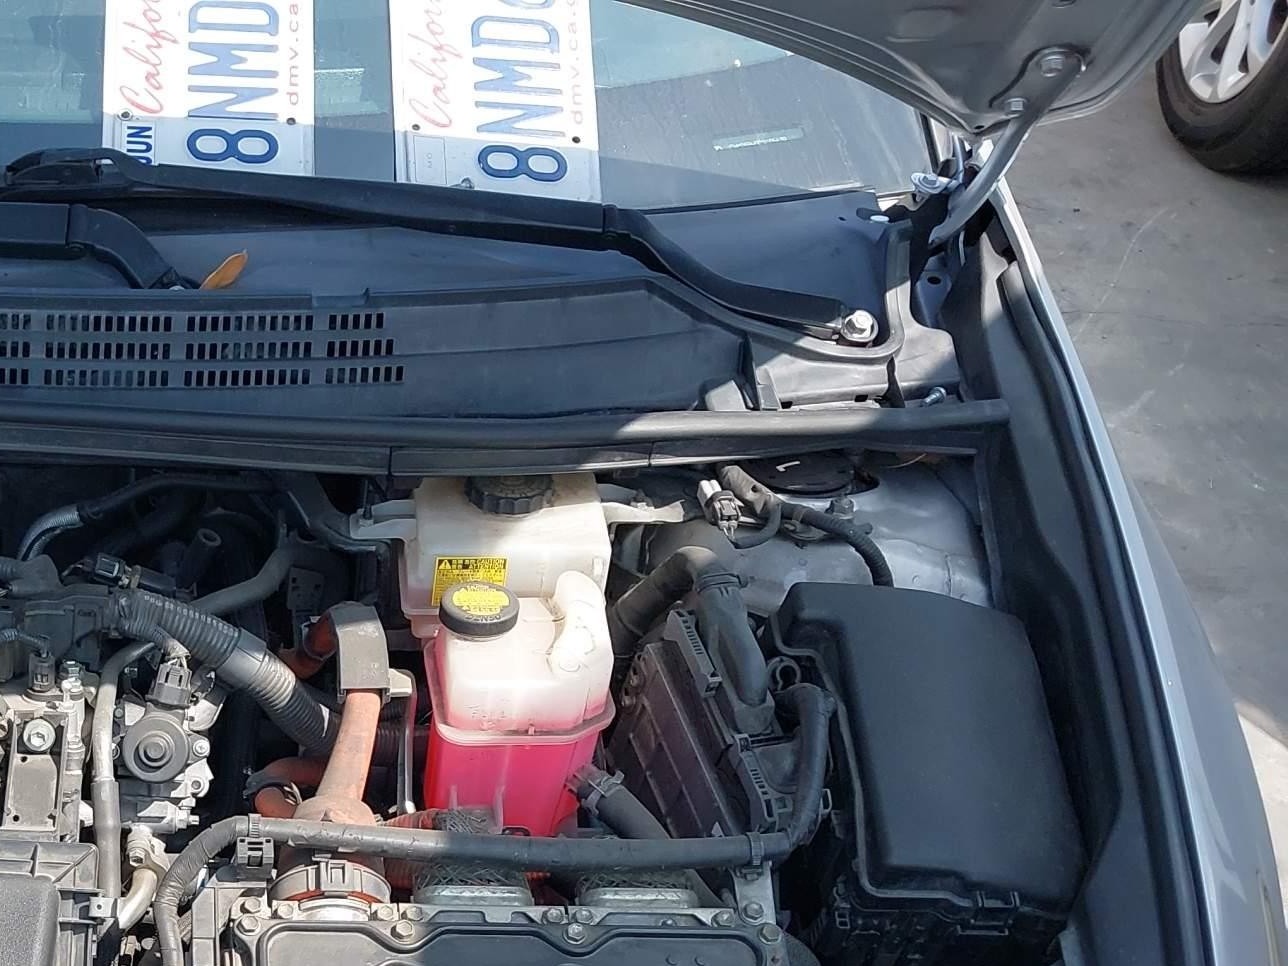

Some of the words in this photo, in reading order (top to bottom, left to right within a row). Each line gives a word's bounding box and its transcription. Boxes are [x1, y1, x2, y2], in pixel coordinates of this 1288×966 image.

[119, 0, 179, 115] Califo
[408, 0, 462, 128] Califor
[470, 0, 568, 183] 8NMD
